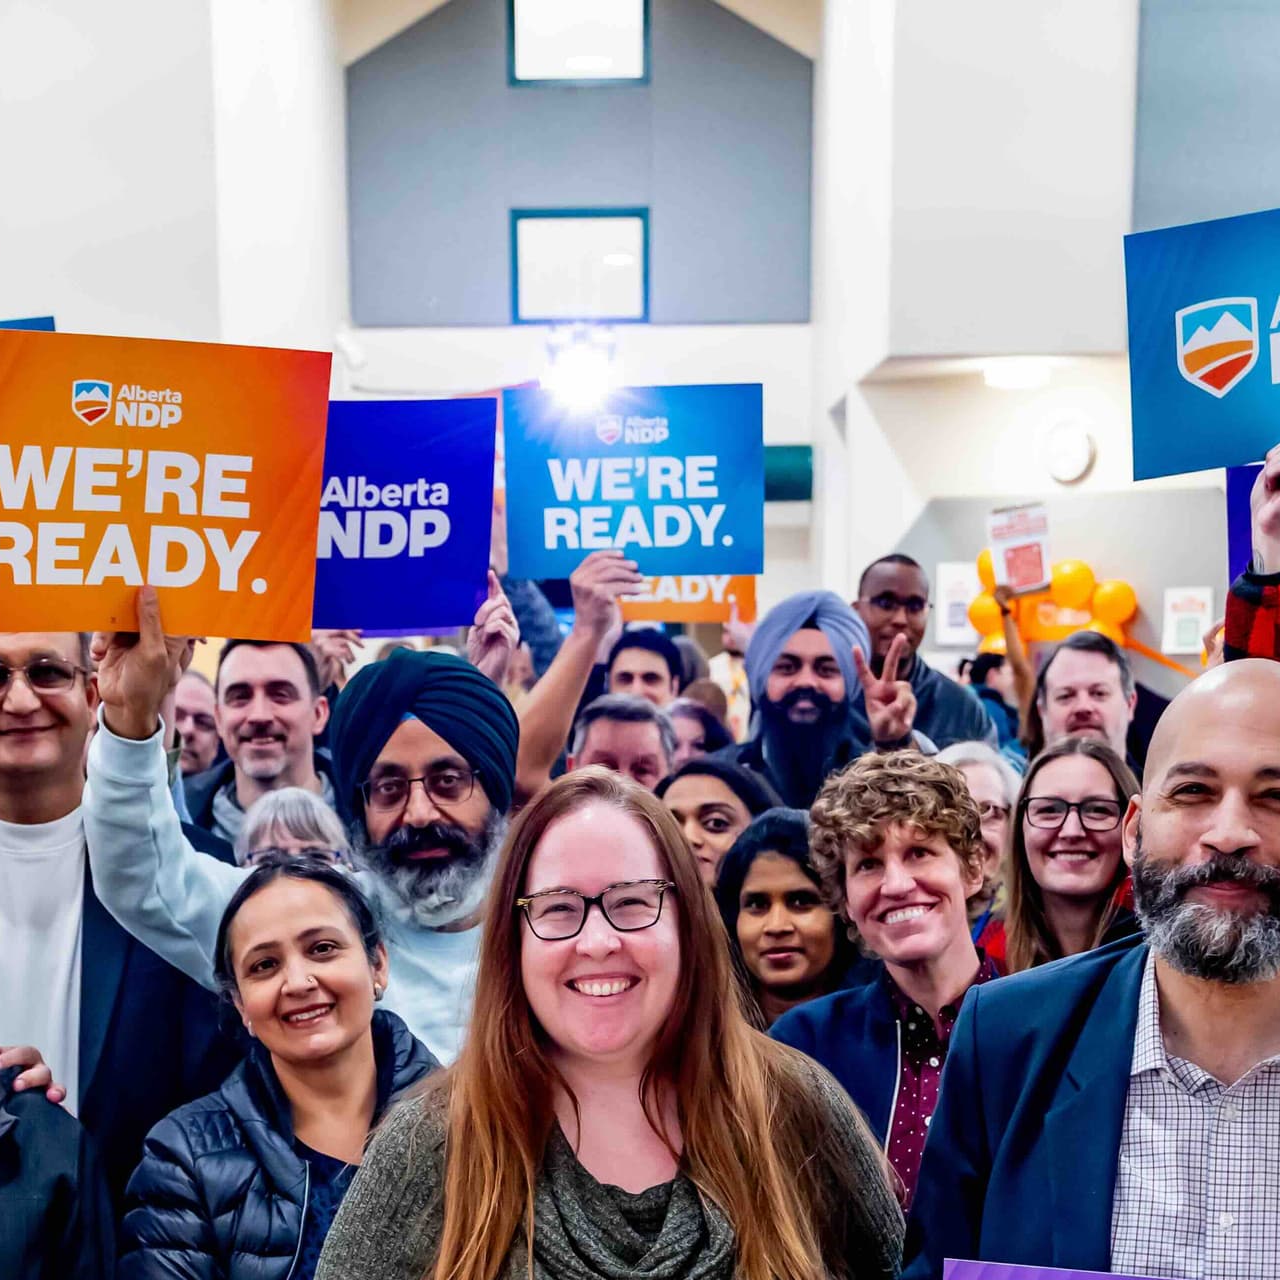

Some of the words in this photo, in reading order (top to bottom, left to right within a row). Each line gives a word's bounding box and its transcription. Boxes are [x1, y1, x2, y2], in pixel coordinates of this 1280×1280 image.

[117, 384, 182, 404] Alberta
[115, 401, 182, 428] NDP
[624, 416, 669, 430] Alberta
[624, 427, 669, 444] NDP
[319, 476, 449, 507] Alberta
[547, 455, 718, 501] WE'RE
[317, 510, 450, 558] NDP
[543, 504, 733, 549] READY.
[621, 575, 736, 604] EADY.
